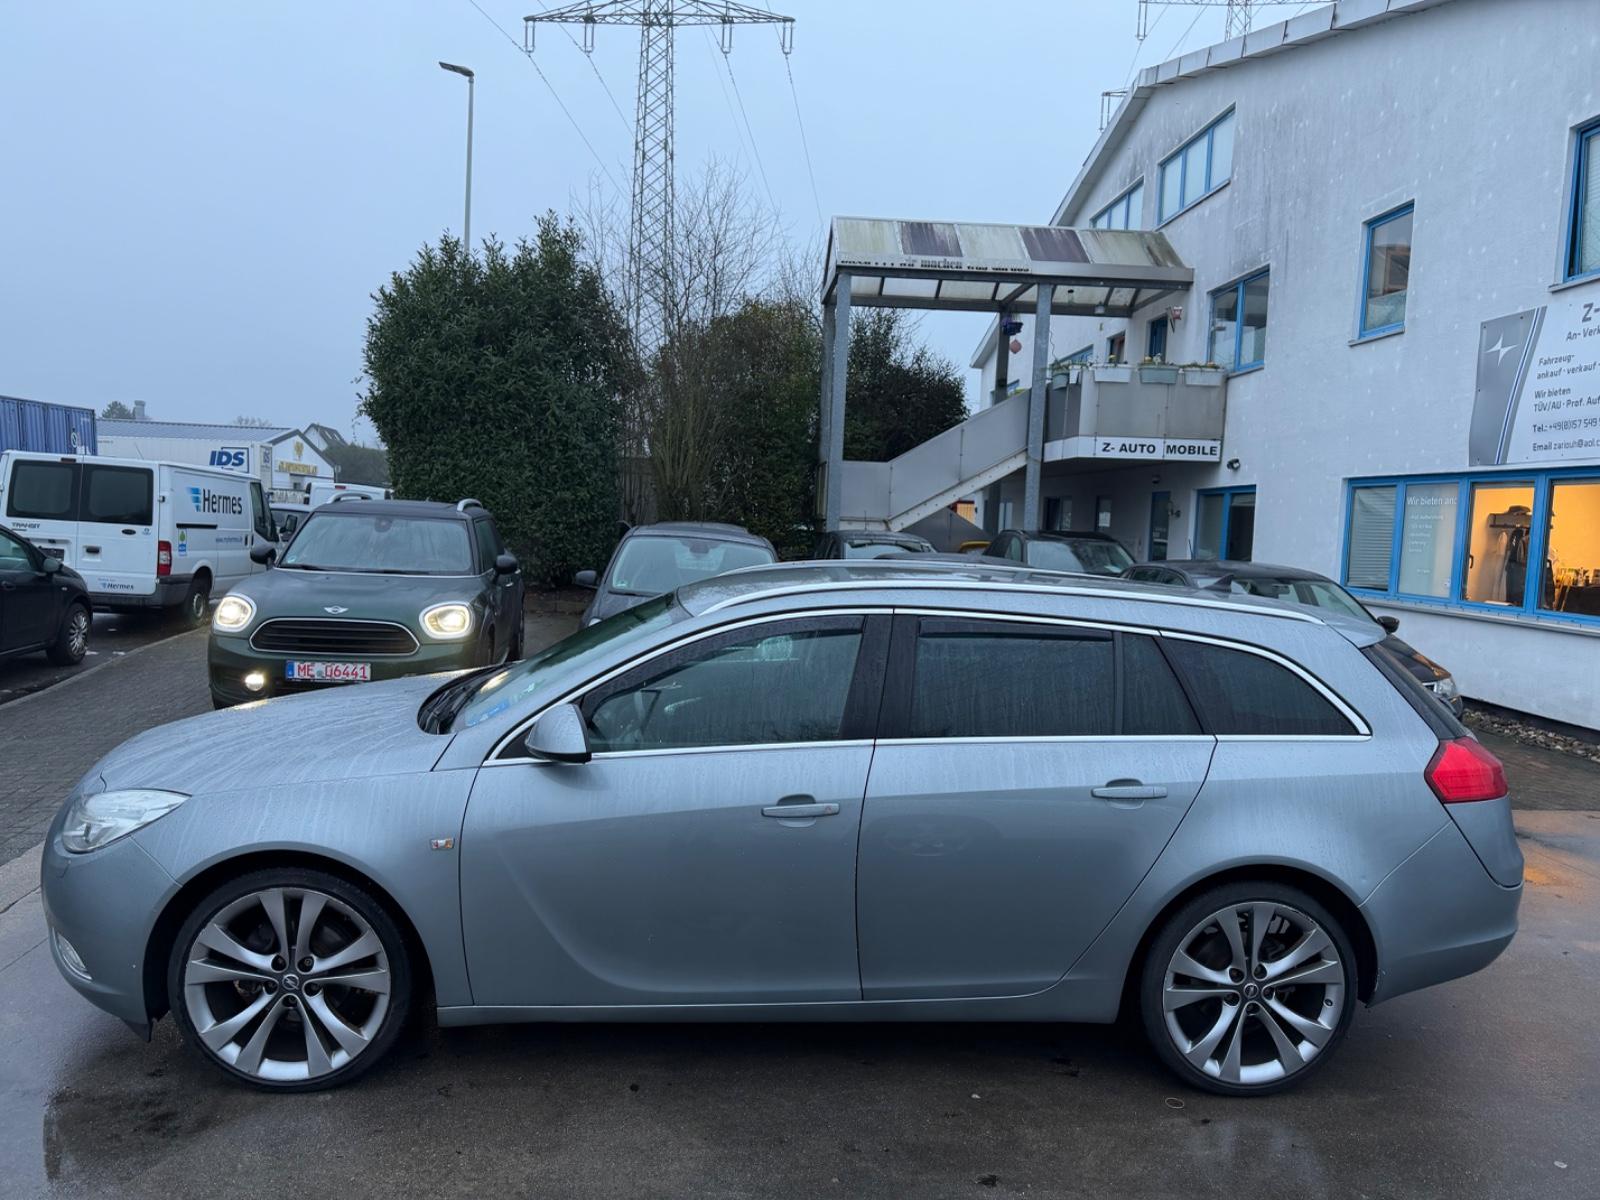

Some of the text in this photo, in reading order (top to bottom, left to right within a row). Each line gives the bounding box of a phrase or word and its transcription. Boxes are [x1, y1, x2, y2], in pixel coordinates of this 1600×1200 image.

[1534, 388, 1571, 399] Wir bieten
[1102, 442, 1218, 456] Z- AUTO MOBILE
[209, 450, 245, 467] IDS
[202, 488, 243, 514] Hermes
[1407, 496, 1419, 505] Wir
[107, 582, 134, 590] Hermes
[297, 664, 315, 678] ME
